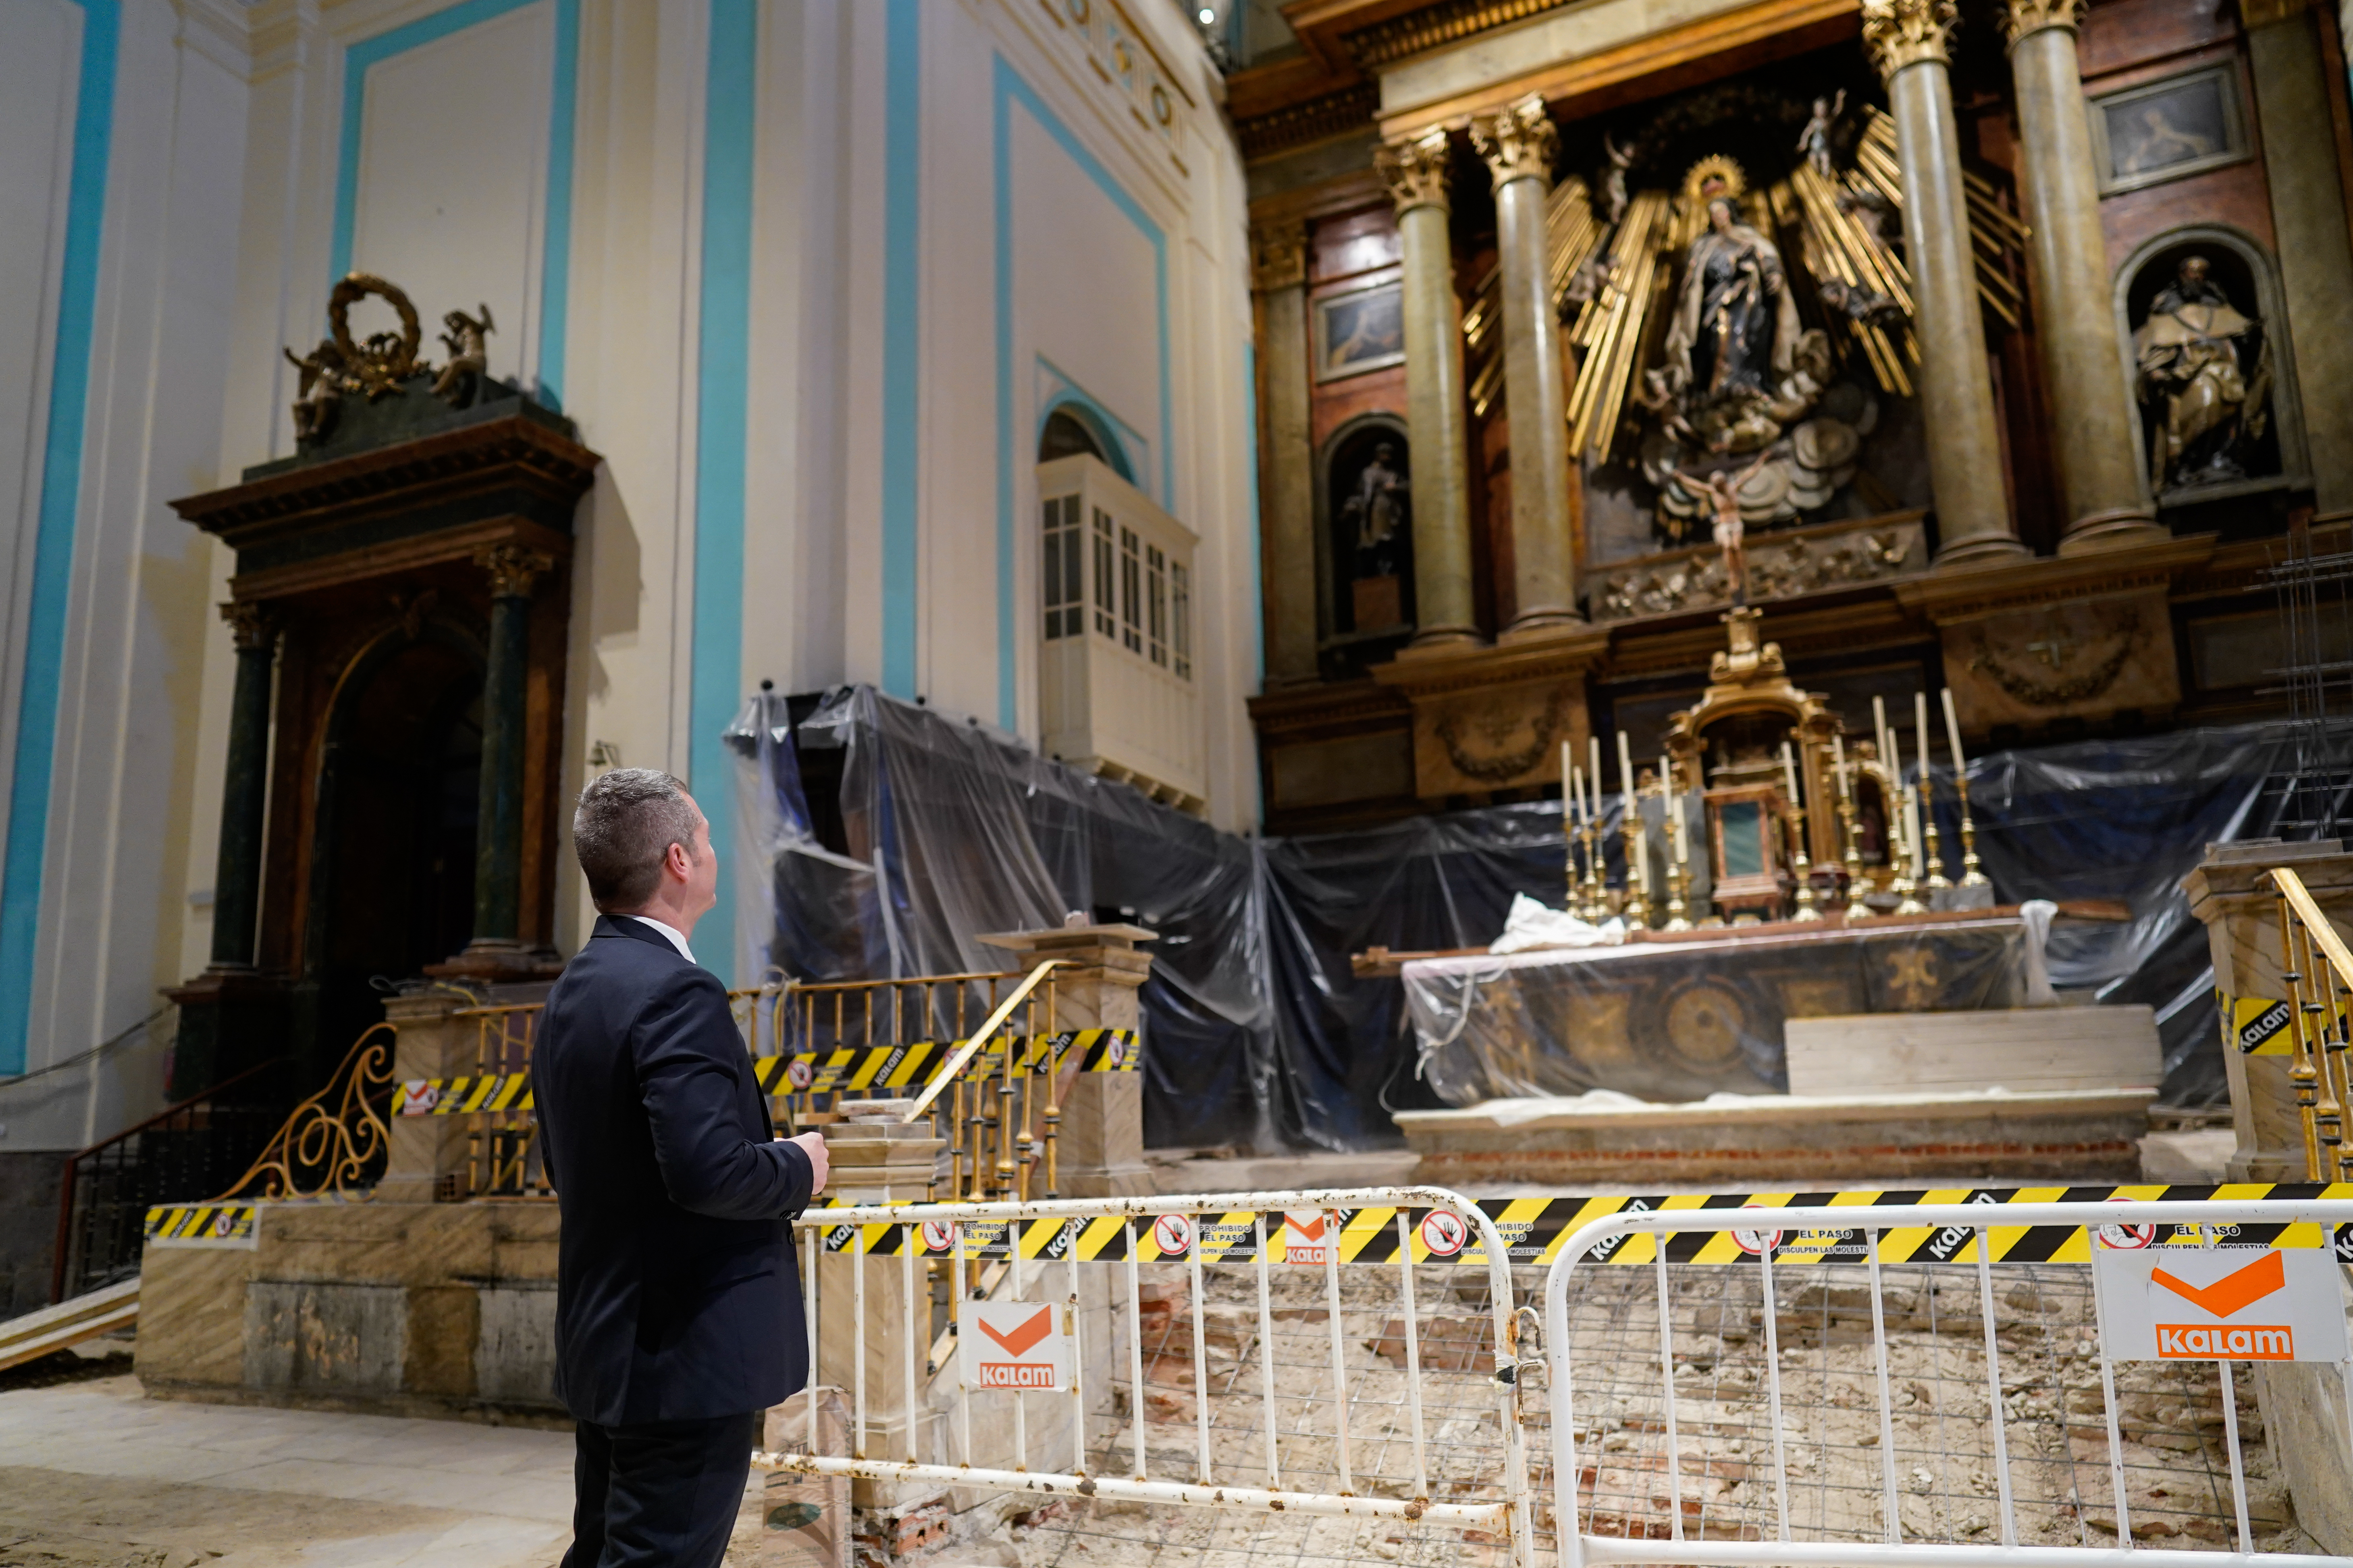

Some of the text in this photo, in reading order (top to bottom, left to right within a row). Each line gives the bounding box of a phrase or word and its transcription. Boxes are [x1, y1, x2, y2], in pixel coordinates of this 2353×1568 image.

[964, 1223, 1006, 1231] ROHIBIDO
[2176, 1227, 2195, 1235] EL
[1800, 1230, 1852, 1239] EL PASO
